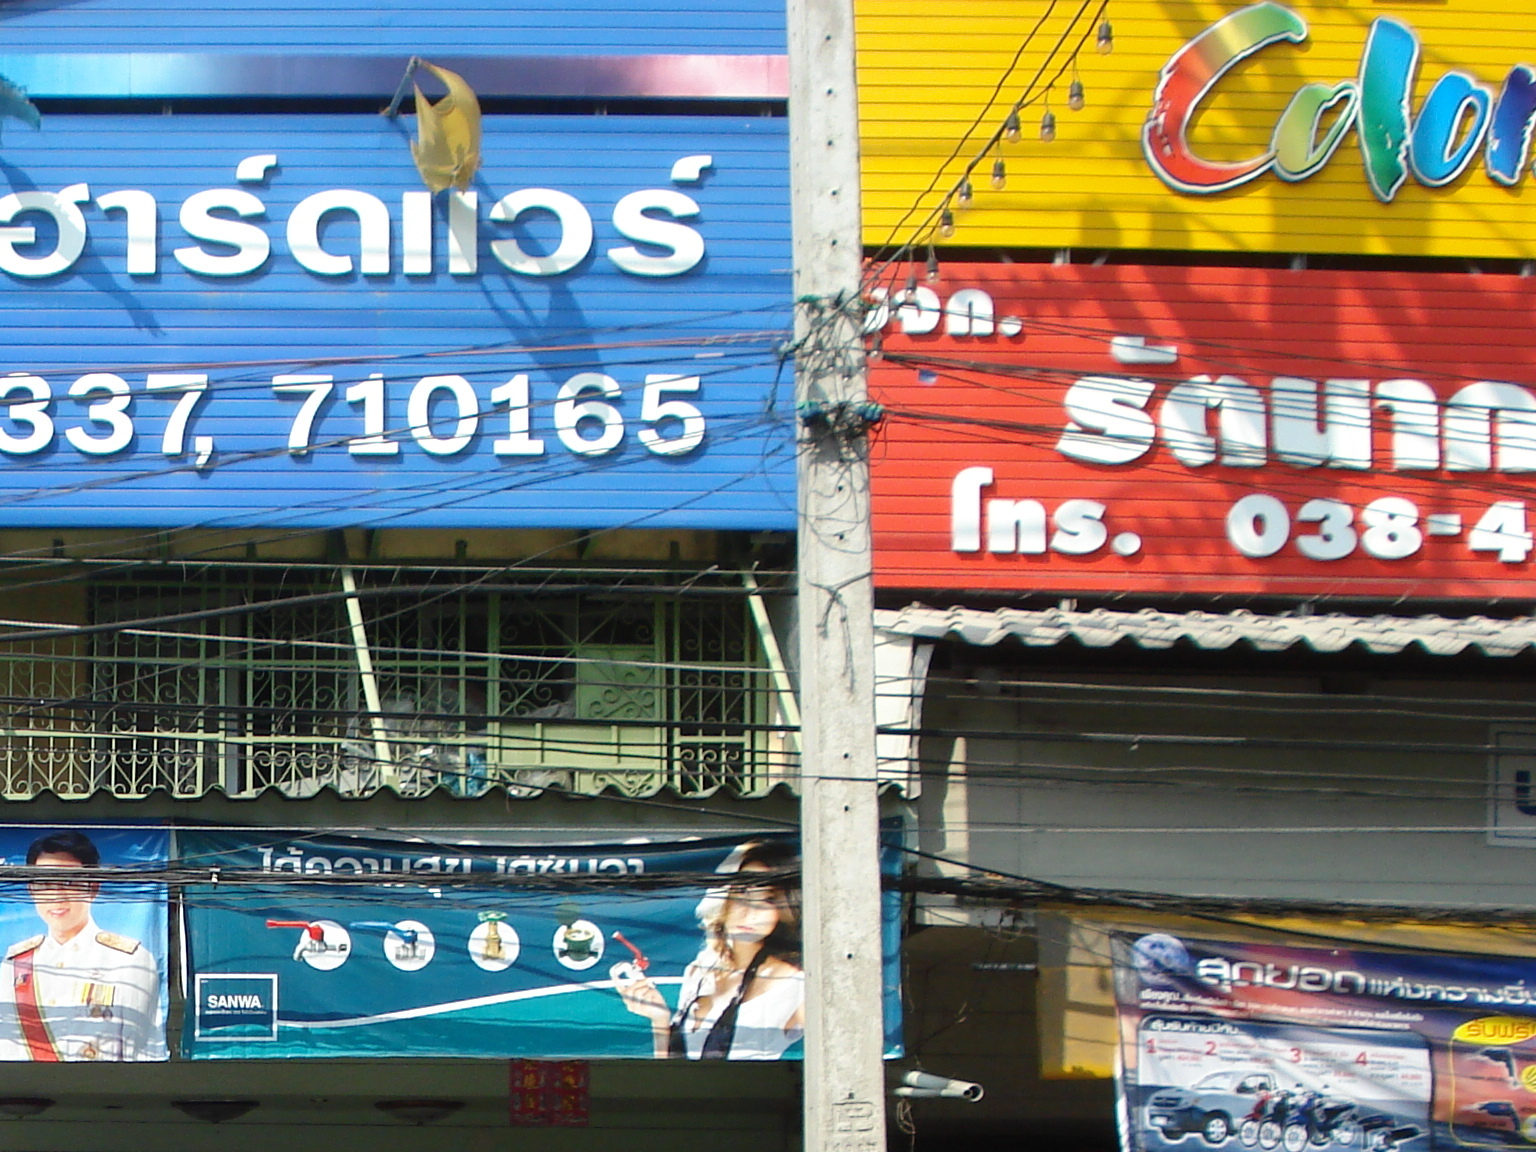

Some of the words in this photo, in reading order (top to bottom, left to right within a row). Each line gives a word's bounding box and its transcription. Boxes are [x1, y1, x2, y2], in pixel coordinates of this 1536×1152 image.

[271, 372, 707, 459] 710165
[950, 465, 1143, 557] โทร.
[207, 994, 262, 1009] SANWA
